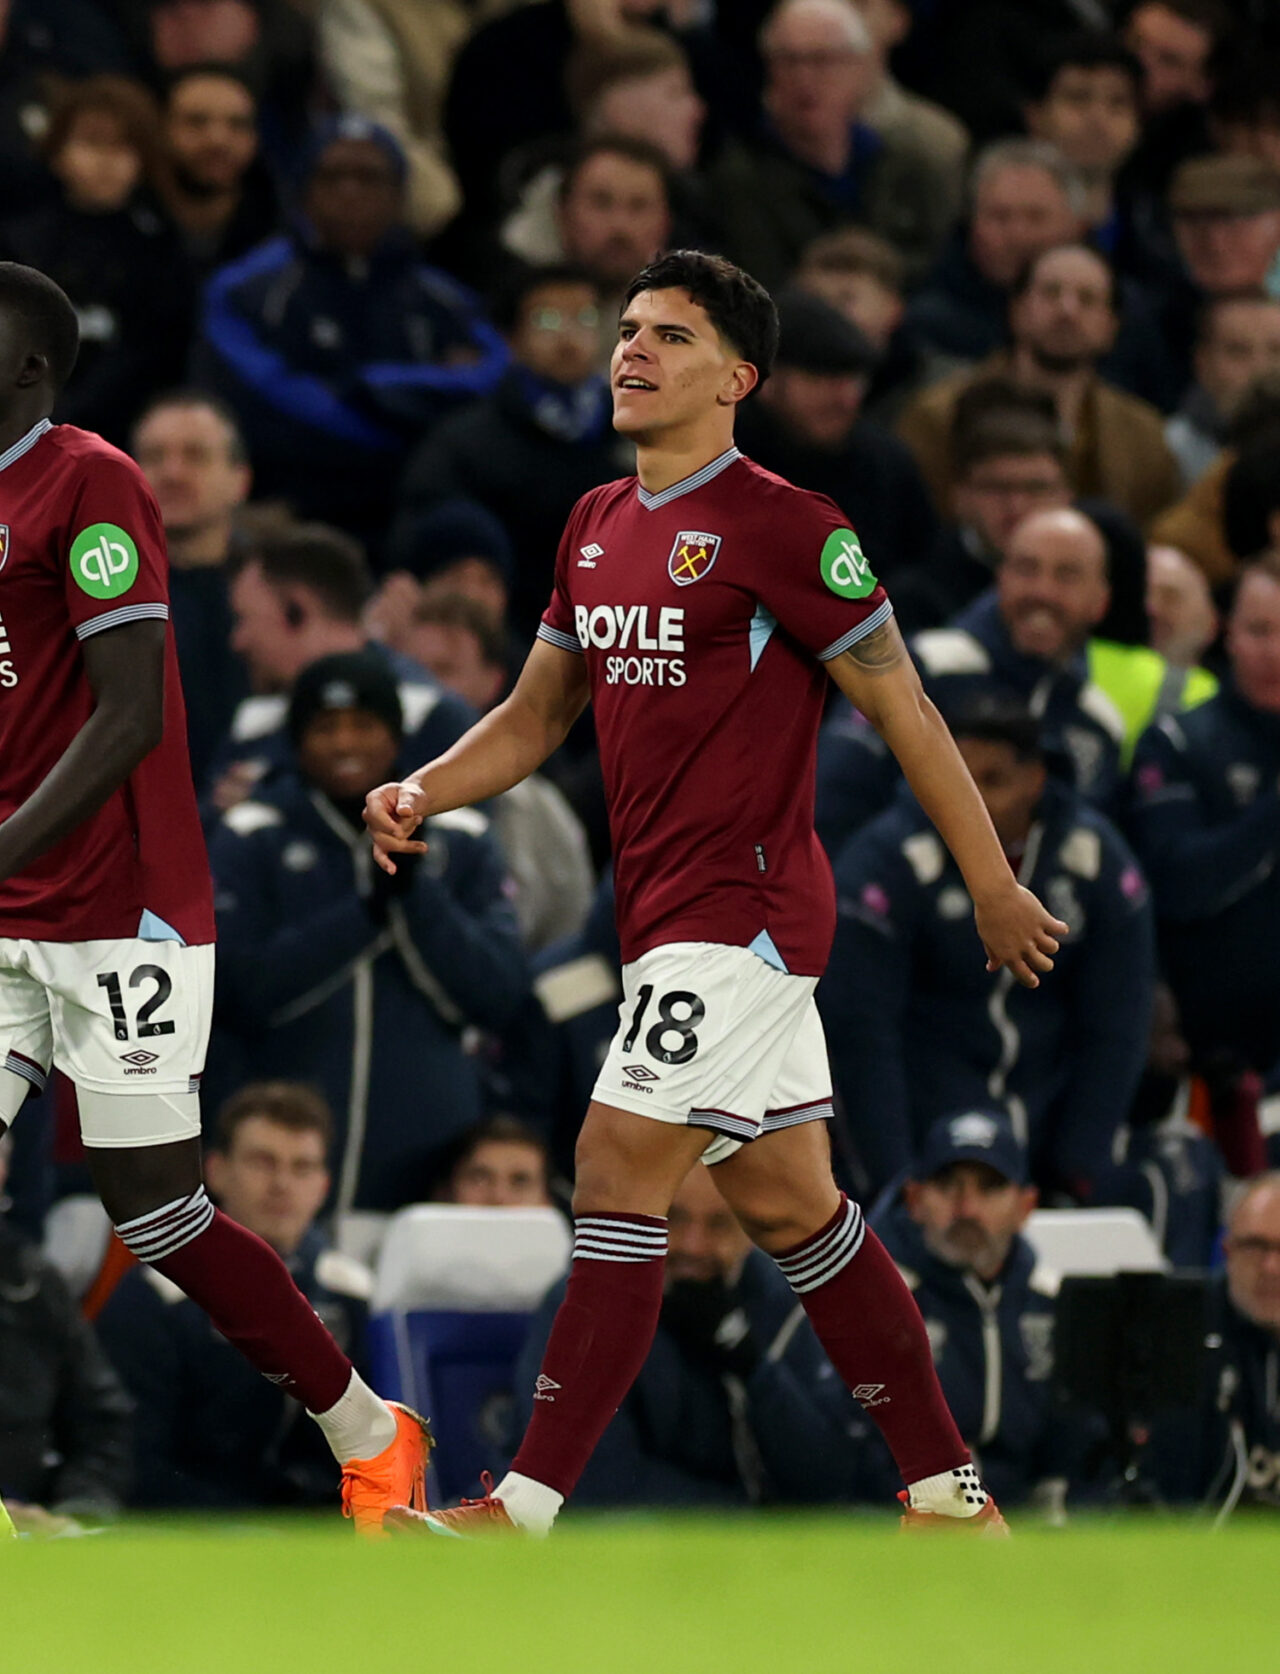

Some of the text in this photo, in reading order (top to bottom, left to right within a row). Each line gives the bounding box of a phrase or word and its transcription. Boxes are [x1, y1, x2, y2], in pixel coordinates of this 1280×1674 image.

[575, 605, 685, 652] BOYLE
[606, 656, 687, 687] SPORTS
[96, 963, 176, 1041] 12
[622, 984, 705, 1065] 18
[123, 1066, 158, 1075] umbro
[621, 1080, 653, 1094] umbro
